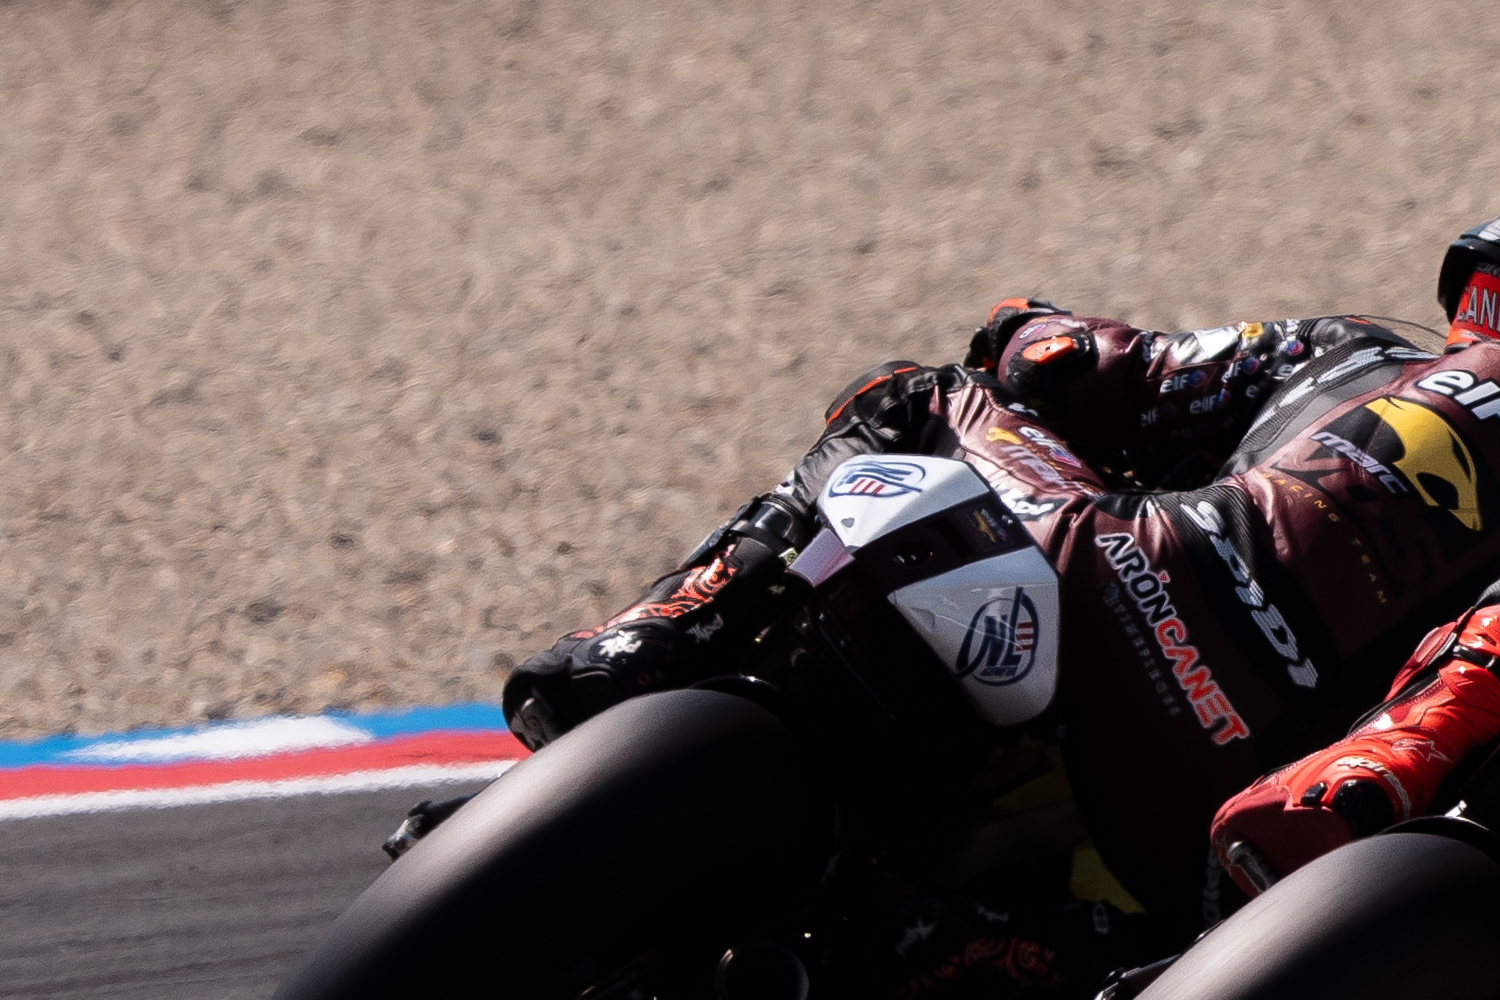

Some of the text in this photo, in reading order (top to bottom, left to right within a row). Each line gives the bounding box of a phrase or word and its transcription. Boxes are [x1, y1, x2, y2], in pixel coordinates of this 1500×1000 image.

[1160, 375, 1189, 395] elf
[1190, 394, 1218, 415] elf
[1309, 431, 1410, 495] marc
